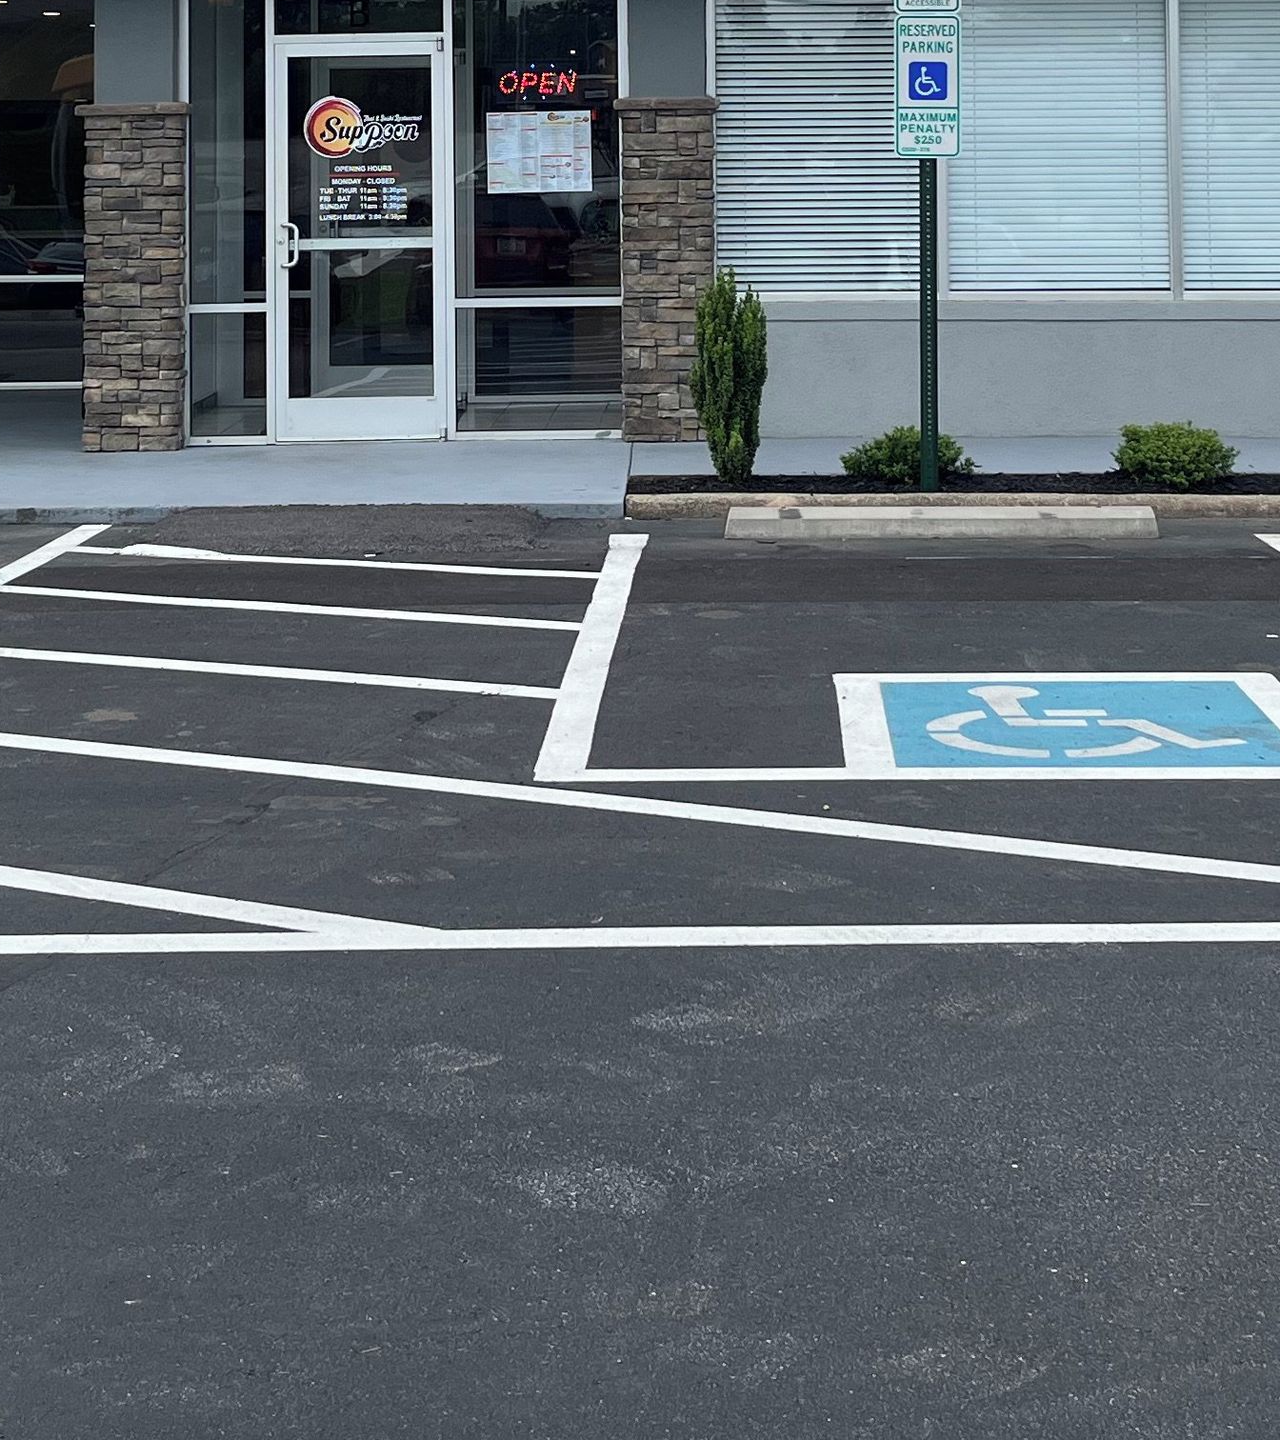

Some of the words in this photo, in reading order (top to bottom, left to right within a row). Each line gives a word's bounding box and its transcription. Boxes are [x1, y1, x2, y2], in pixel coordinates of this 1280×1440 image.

[905, 0, 950, 7] ACCESSIBLE
[900, 24, 956, 37] RESERVED
[903, 41, 953, 54] PARKING
[499, 71, 577, 94] OPEN
[900, 113, 956, 122] MAXIMUM
[900, 124, 956, 133] PENALTY
[914, 135, 942, 145] $250
